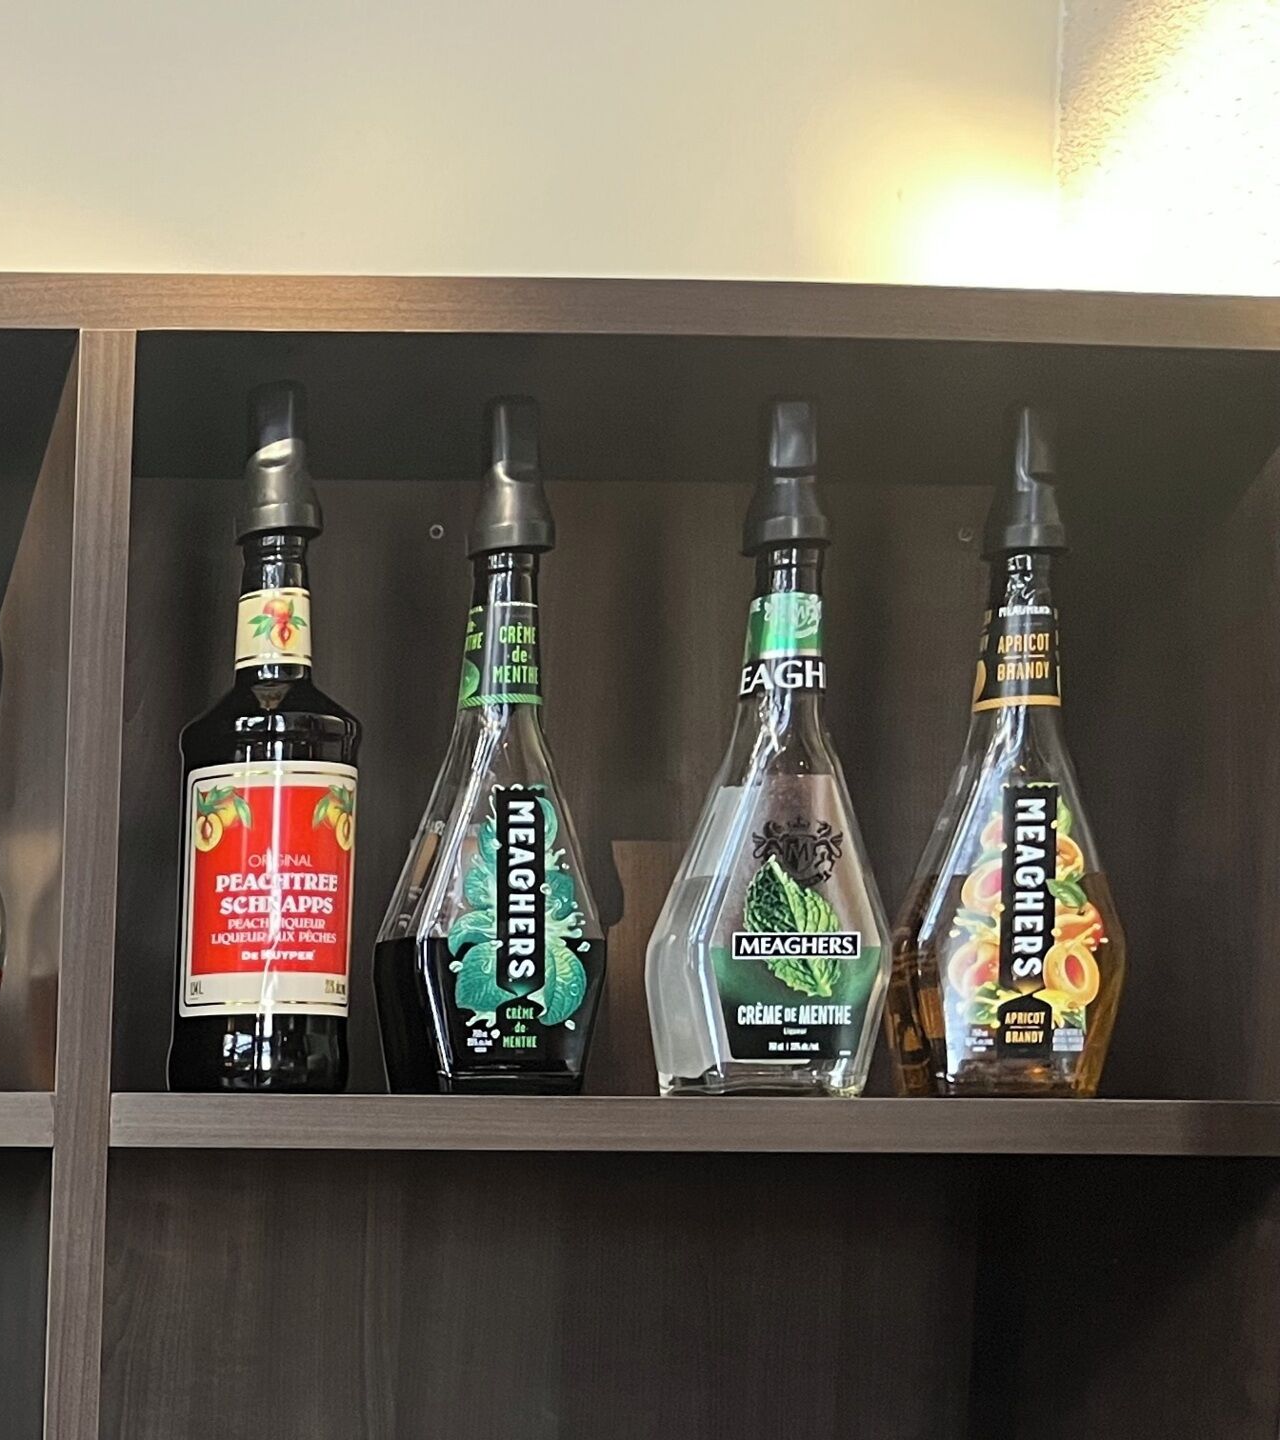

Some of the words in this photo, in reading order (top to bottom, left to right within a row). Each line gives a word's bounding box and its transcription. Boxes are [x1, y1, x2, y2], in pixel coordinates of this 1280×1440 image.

[499, 621, 536, 645] CRÈME
[997, 632, 1050, 655] APRICOT
[492, 665, 539, 685] MENTHE
[997, 661, 1050, 682] BRANDY
[248, 853, 313, 868] ORGINAL
[215, 872, 338, 893] PEACHTREE
[508, 800, 536, 980] MEAGHERS
[1013, 798, 1046, 980] MEAGHERS
[219, 895, 334, 915] SCHNAPPS
[228, 918, 270, 930] PEACH
[272, 918, 326, 930] IQUEUR
[211, 931, 267, 945] LIQUEUR
[298, 930, 337, 944] PÊCHES
[739, 936, 854, 955] MEAGHERS
[505, 1005, 535, 1020] CRÈME
[737, 1002, 783, 1025] CRÈME
[784, 1007, 797, 1023] DE
[798, 1005, 852, 1025] MENTHE
[1005, 1011, 1045, 1025] APRICOT
[502, 1035, 538, 1048] MENTHE
[1005, 1031, 1044, 1043] BRANDY
